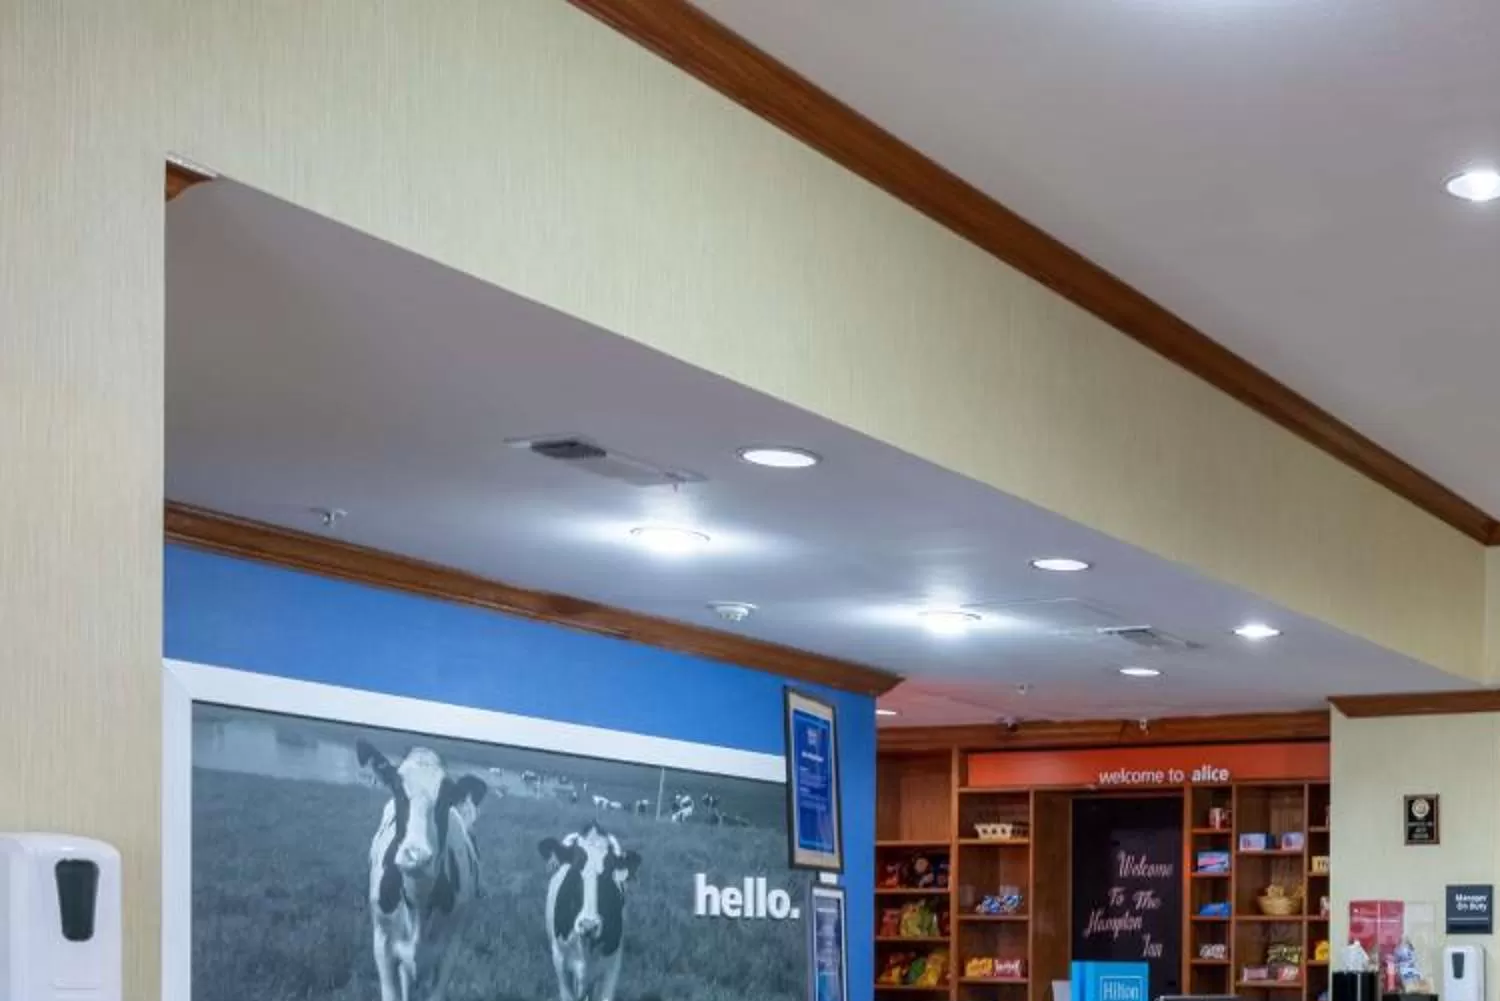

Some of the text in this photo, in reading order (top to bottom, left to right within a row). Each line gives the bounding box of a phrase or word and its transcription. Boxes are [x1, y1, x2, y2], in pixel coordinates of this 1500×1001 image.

[1099, 764, 1230, 784] welcome to alice
[695, 873, 800, 919] hello.
[1103, 981, 1139, 1001] Hilton
